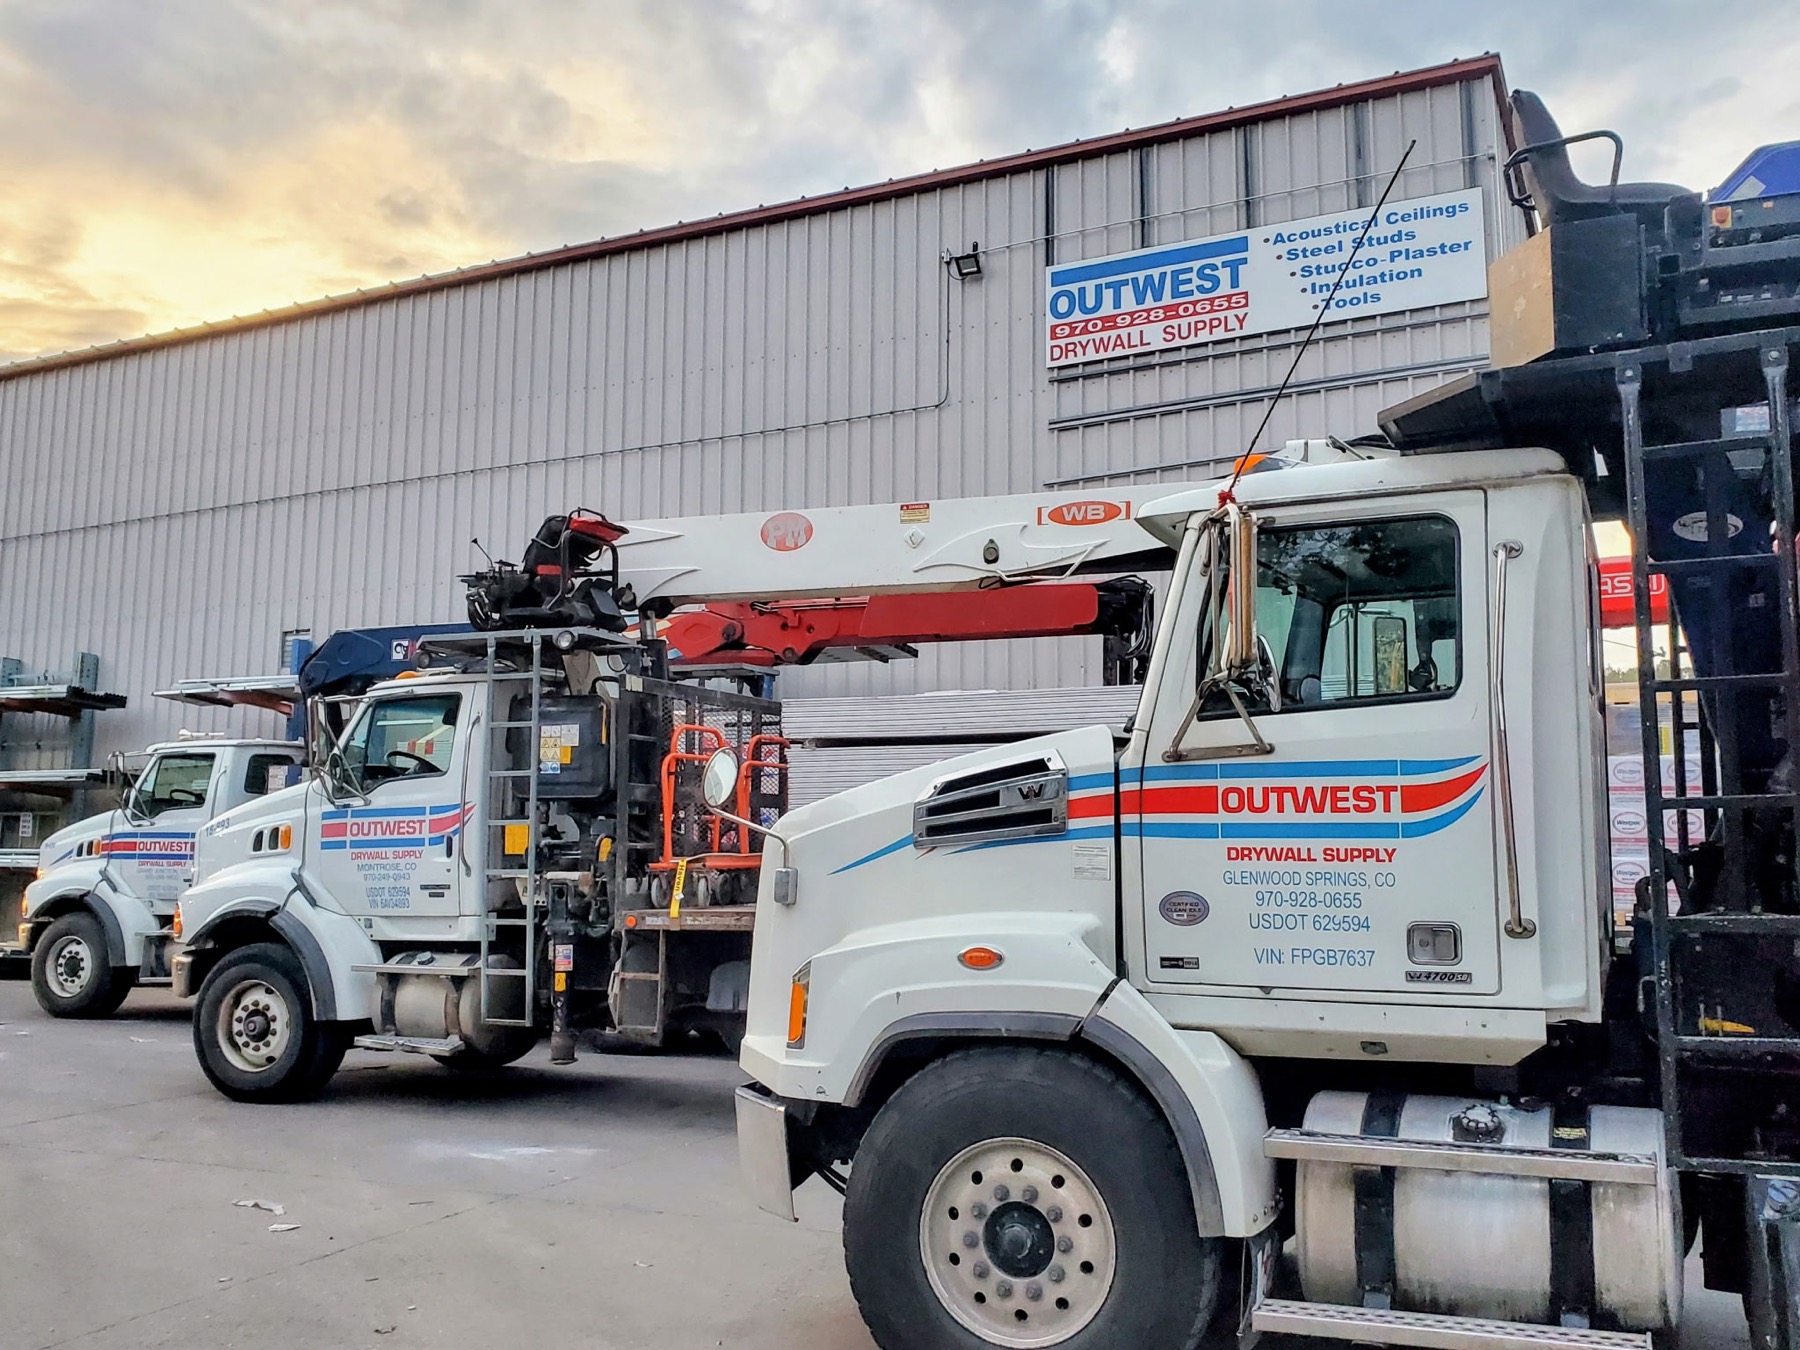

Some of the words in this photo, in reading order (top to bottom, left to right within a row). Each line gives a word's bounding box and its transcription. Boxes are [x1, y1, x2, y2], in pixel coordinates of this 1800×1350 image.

[1272, 214, 1378, 246] Acoustical
[1385, 202, 1470, 226] Ceilings
[1286, 240, 1343, 262] Steel
[1351, 229, 1417, 251] Studs
[1300, 239, 1472, 279] Stucco-Plaster
[1049, 257, 1248, 320] OUTWEST
[1310, 267, 1423, 295] Insulation
[1321, 291, 1382, 311] Tools
[1055, 294, 1247, 338] 970-928-0655
[1049, 329, 1152, 362] DRYWALL
[1162, 312, 1249, 343] SUPPLY
[1061, 504, 1105, 522] WB
[1221, 785, 1399, 814] OUTWEST
[350, 819, 426, 837] OUTWEST
[138, 841, 189, 852] OUTWEST
[351, 851, 389, 861] DRYWALL
[392, 849, 424, 860] SUPPLY
[1226, 846, 1318, 862] DRYWALL
[1322, 847, 1398, 863] SUPPLY
[404, 862, 417, 872] CO
[1222, 870, 1302, 886] GLENWOOD
[1305, 871, 1371, 889] SPRINGS,
[1374, 872, 1396, 888] CO
[1255, 890, 1362, 909] 970-928-0655
[1249, 912, 1309, 931] USDOT
[1312, 914, 1371, 932] 629594
[1253, 947, 1286, 965] VIN:
[1291, 948, 1376, 967] FPGB7637
